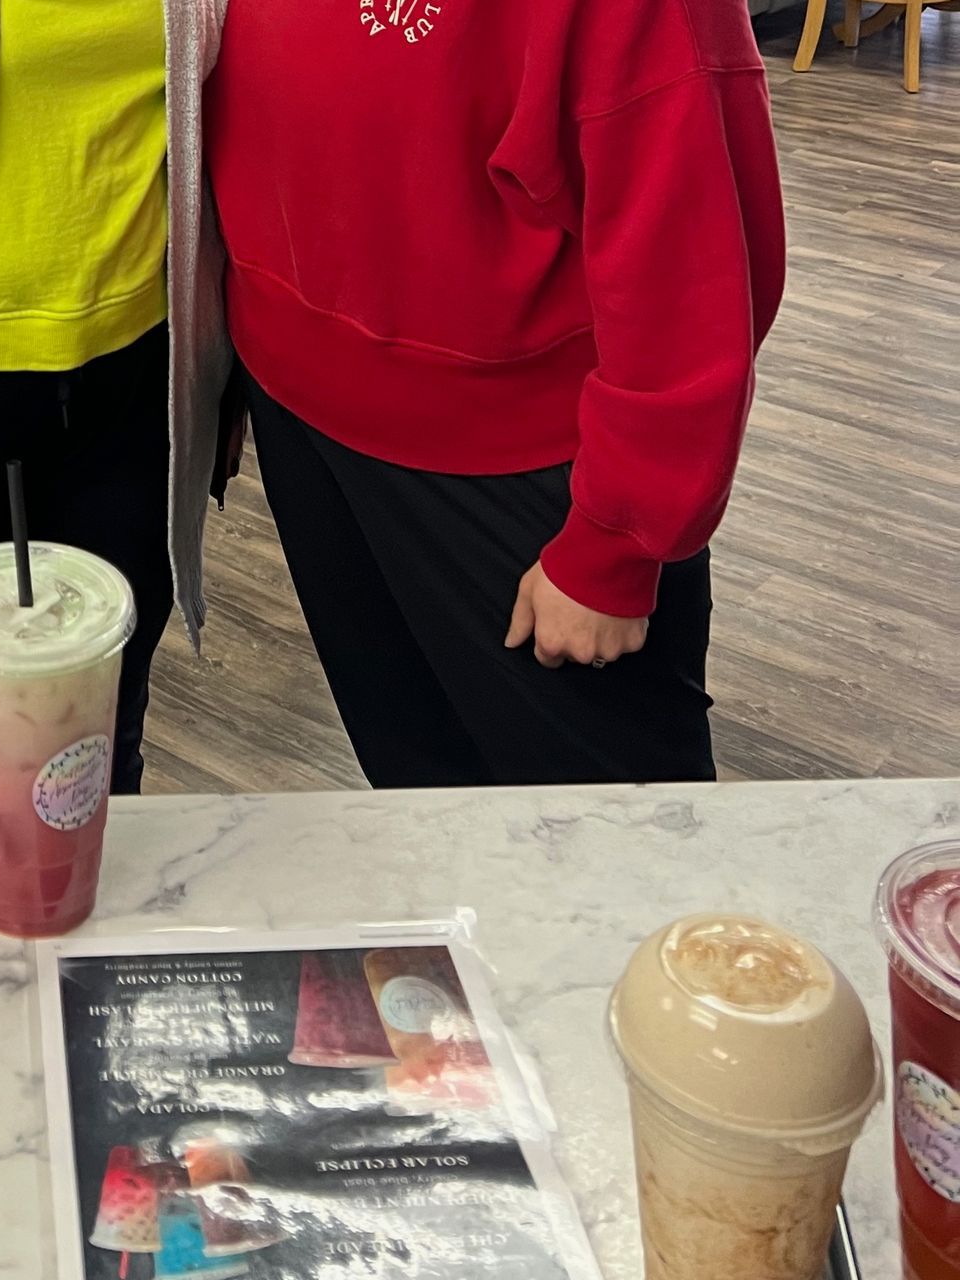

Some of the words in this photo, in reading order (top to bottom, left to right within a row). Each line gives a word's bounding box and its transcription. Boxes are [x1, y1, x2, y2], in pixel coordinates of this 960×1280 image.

[116, 973, 171, 986] CANDY
[176, 972, 243, 985] COTTON
[214, 1065, 285, 1078] ORANGE
[314, 1157, 397, 1172] ECLIPSE
[401, 1154, 470, 1168] SOLAR
